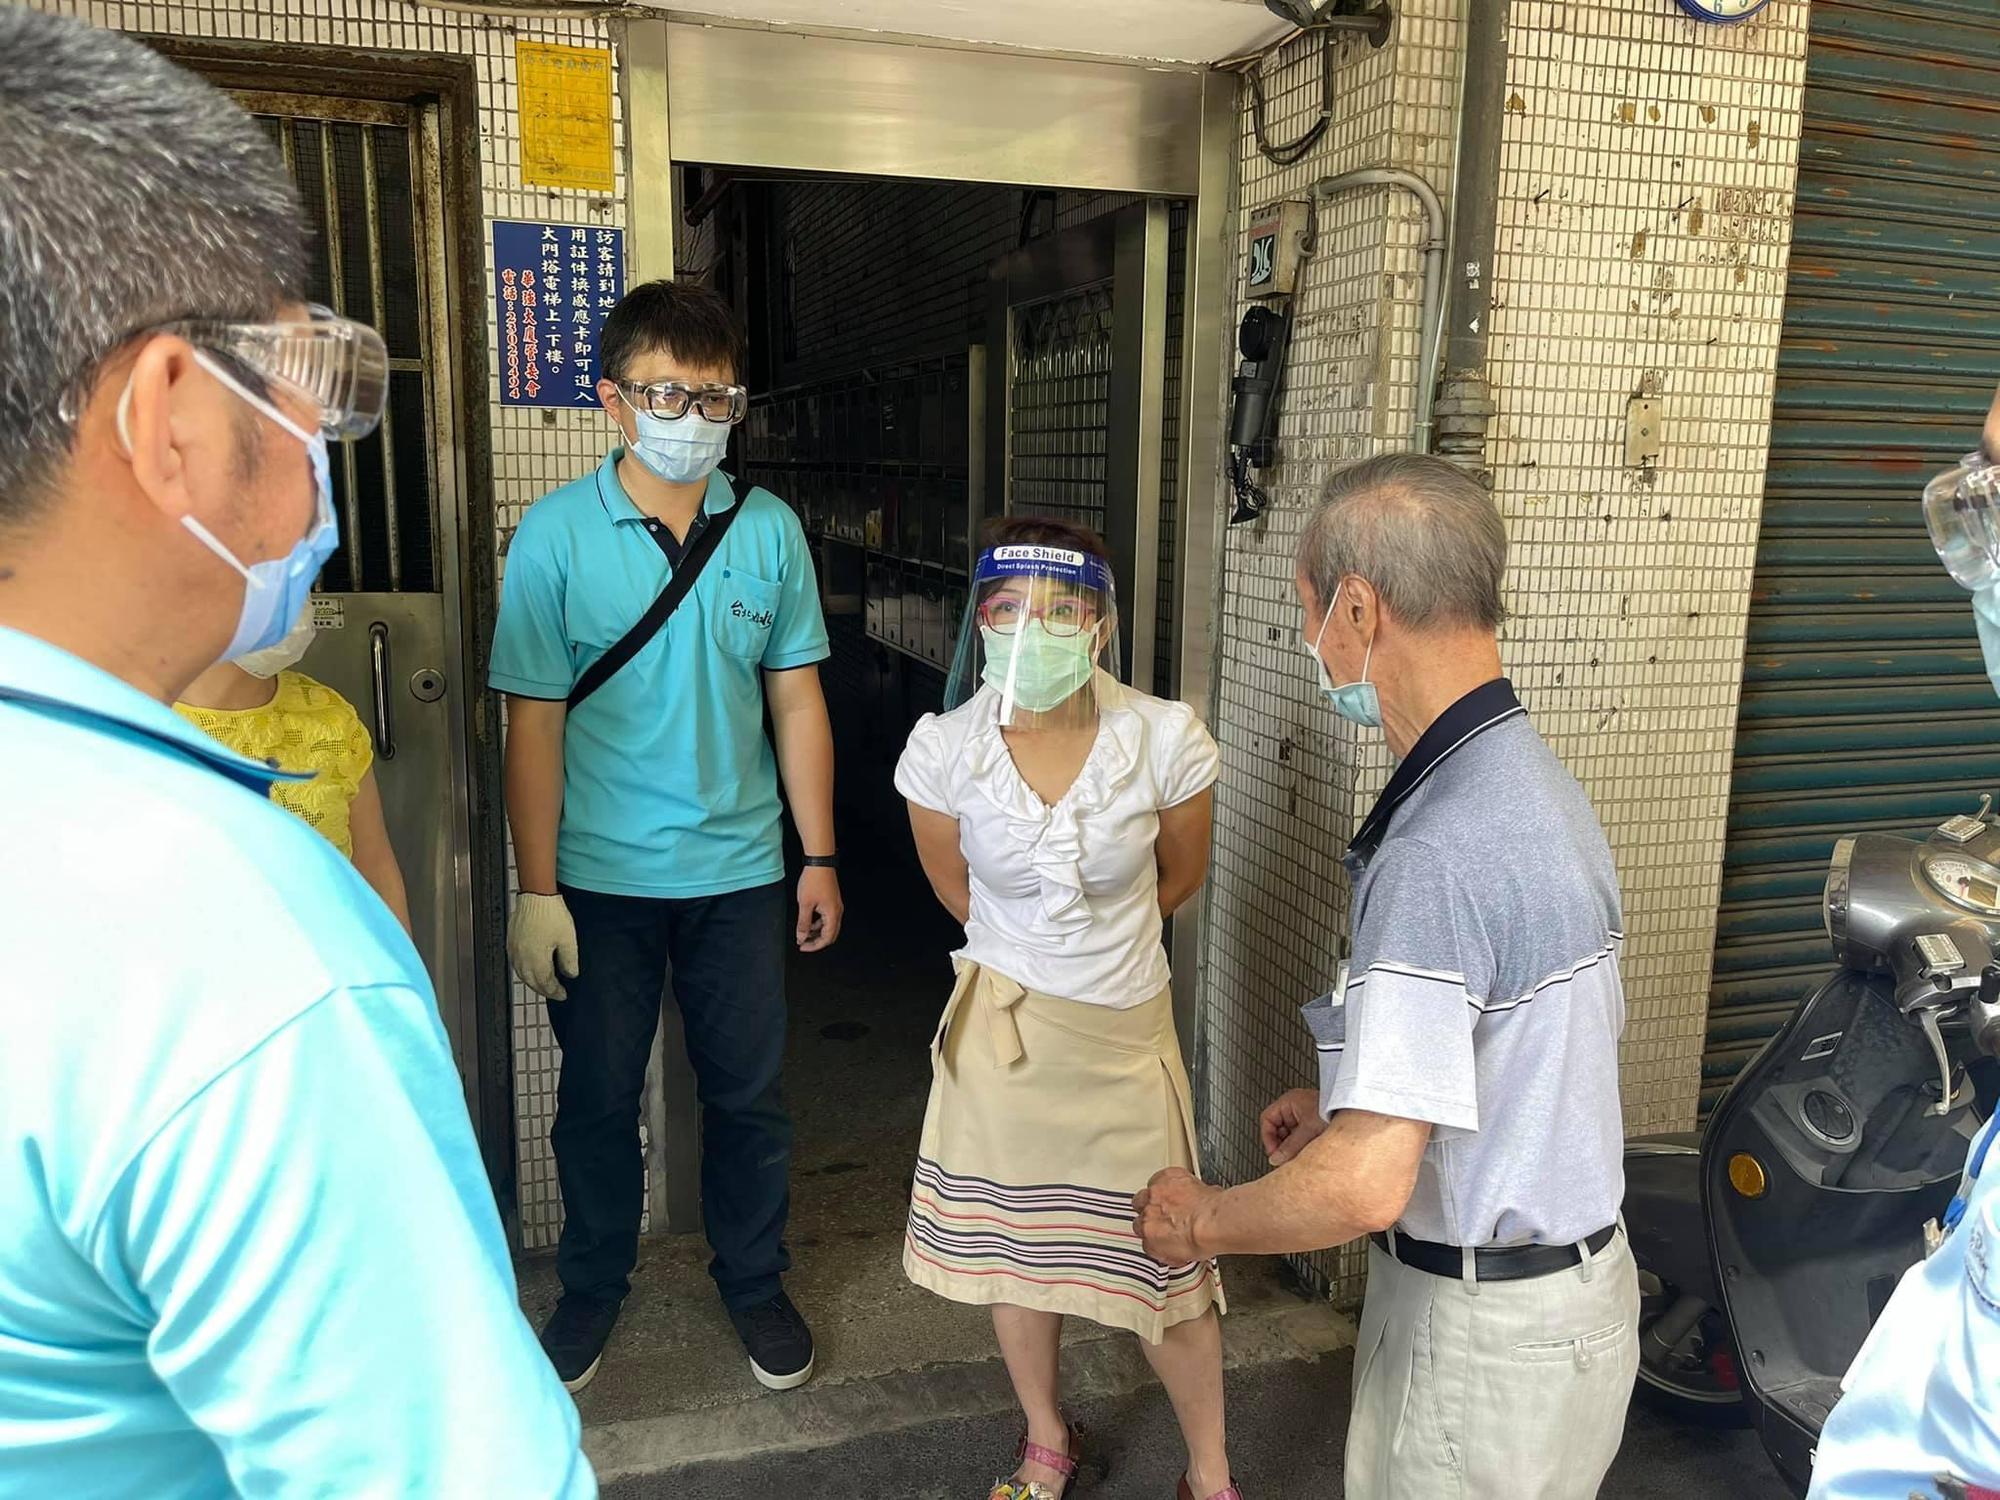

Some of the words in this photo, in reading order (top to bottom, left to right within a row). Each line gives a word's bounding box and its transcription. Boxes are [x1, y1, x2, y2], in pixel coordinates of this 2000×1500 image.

[595, 230, 615, 332] 訪客請到地
[1001, 548, 1030, 558] Face
[1032, 548, 1074, 563] Shield
[1016, 563, 1039, 571] Splash
[1041, 565, 1076, 575] Protection
